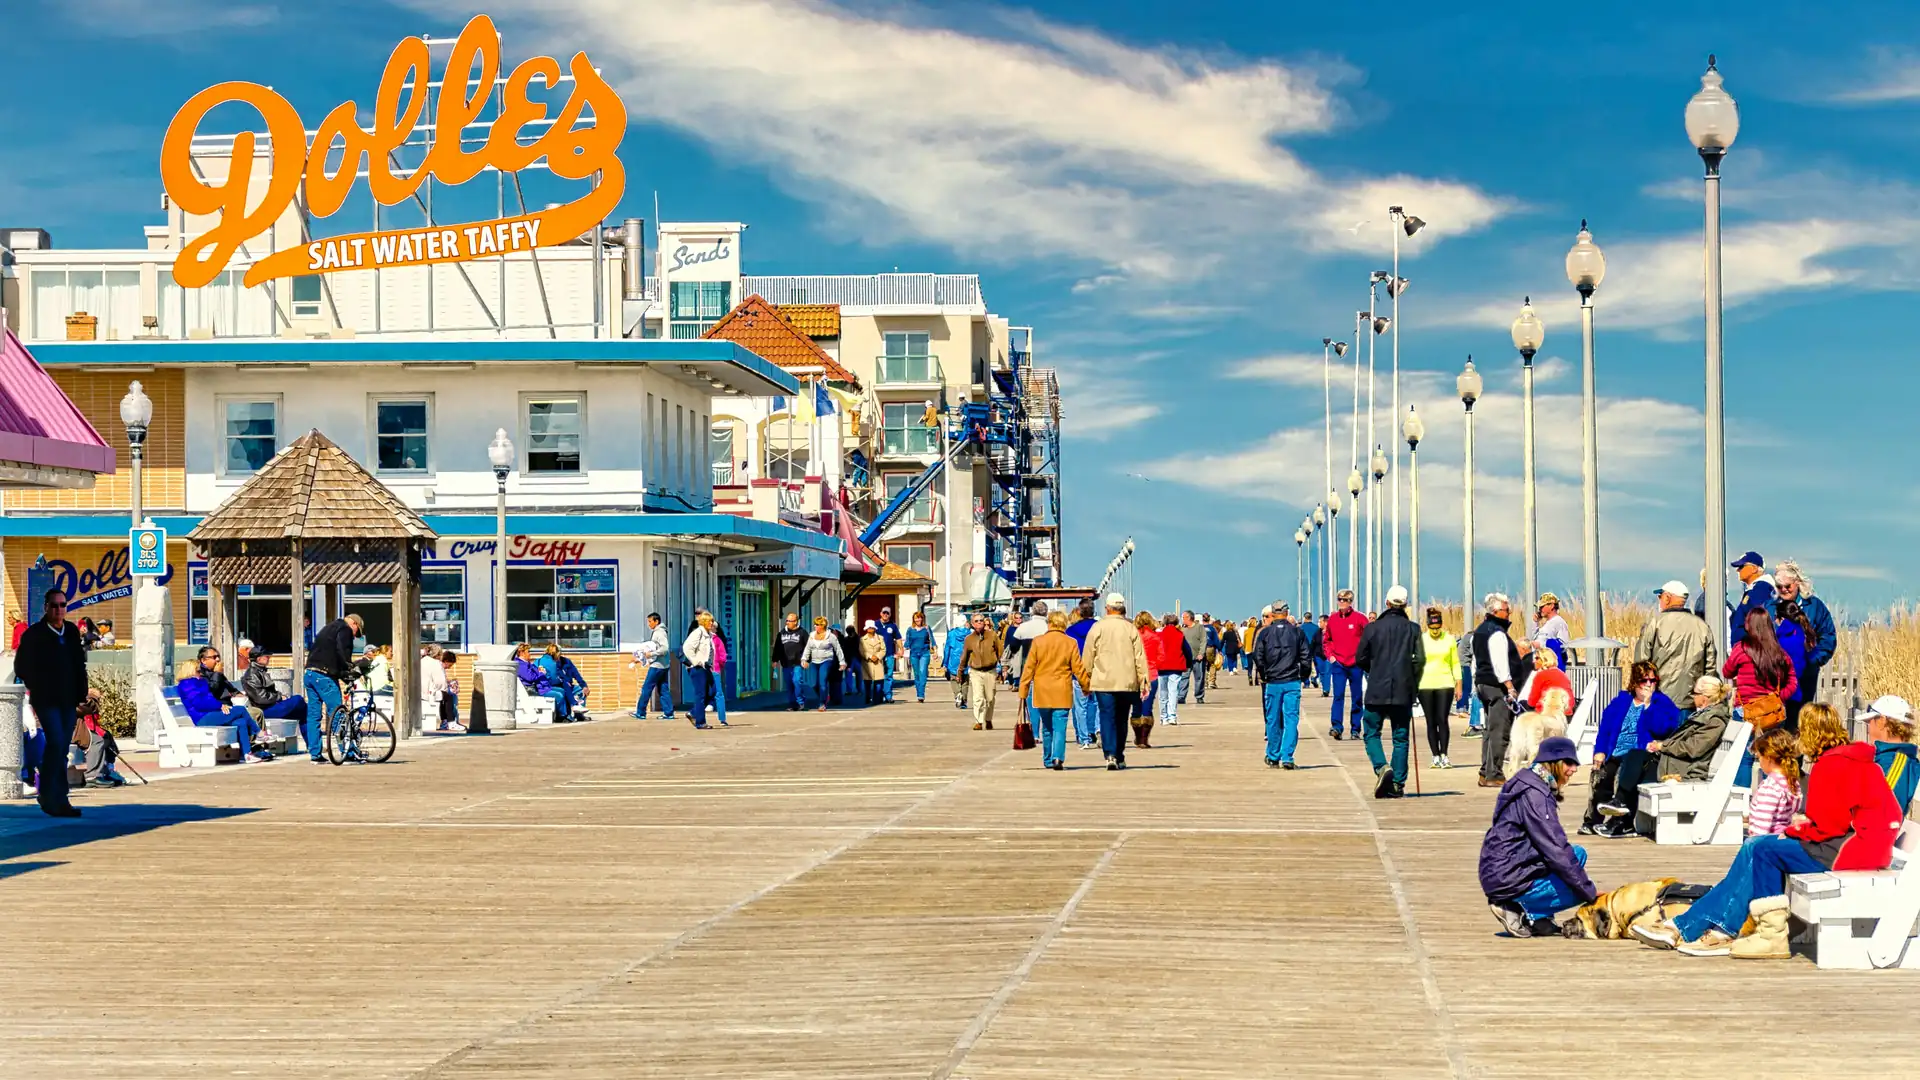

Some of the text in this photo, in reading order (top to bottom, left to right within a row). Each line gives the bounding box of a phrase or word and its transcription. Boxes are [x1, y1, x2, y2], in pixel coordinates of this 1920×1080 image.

[308, 219, 541, 270] SALT WATER TAFFY
[668, 238, 730, 273] Sands
[140, 550, 156, 559] BUS
[509, 535, 585, 566] Taffy
[137, 559, 160, 568] STOP
[81, 587, 129, 606] SALT WATER
